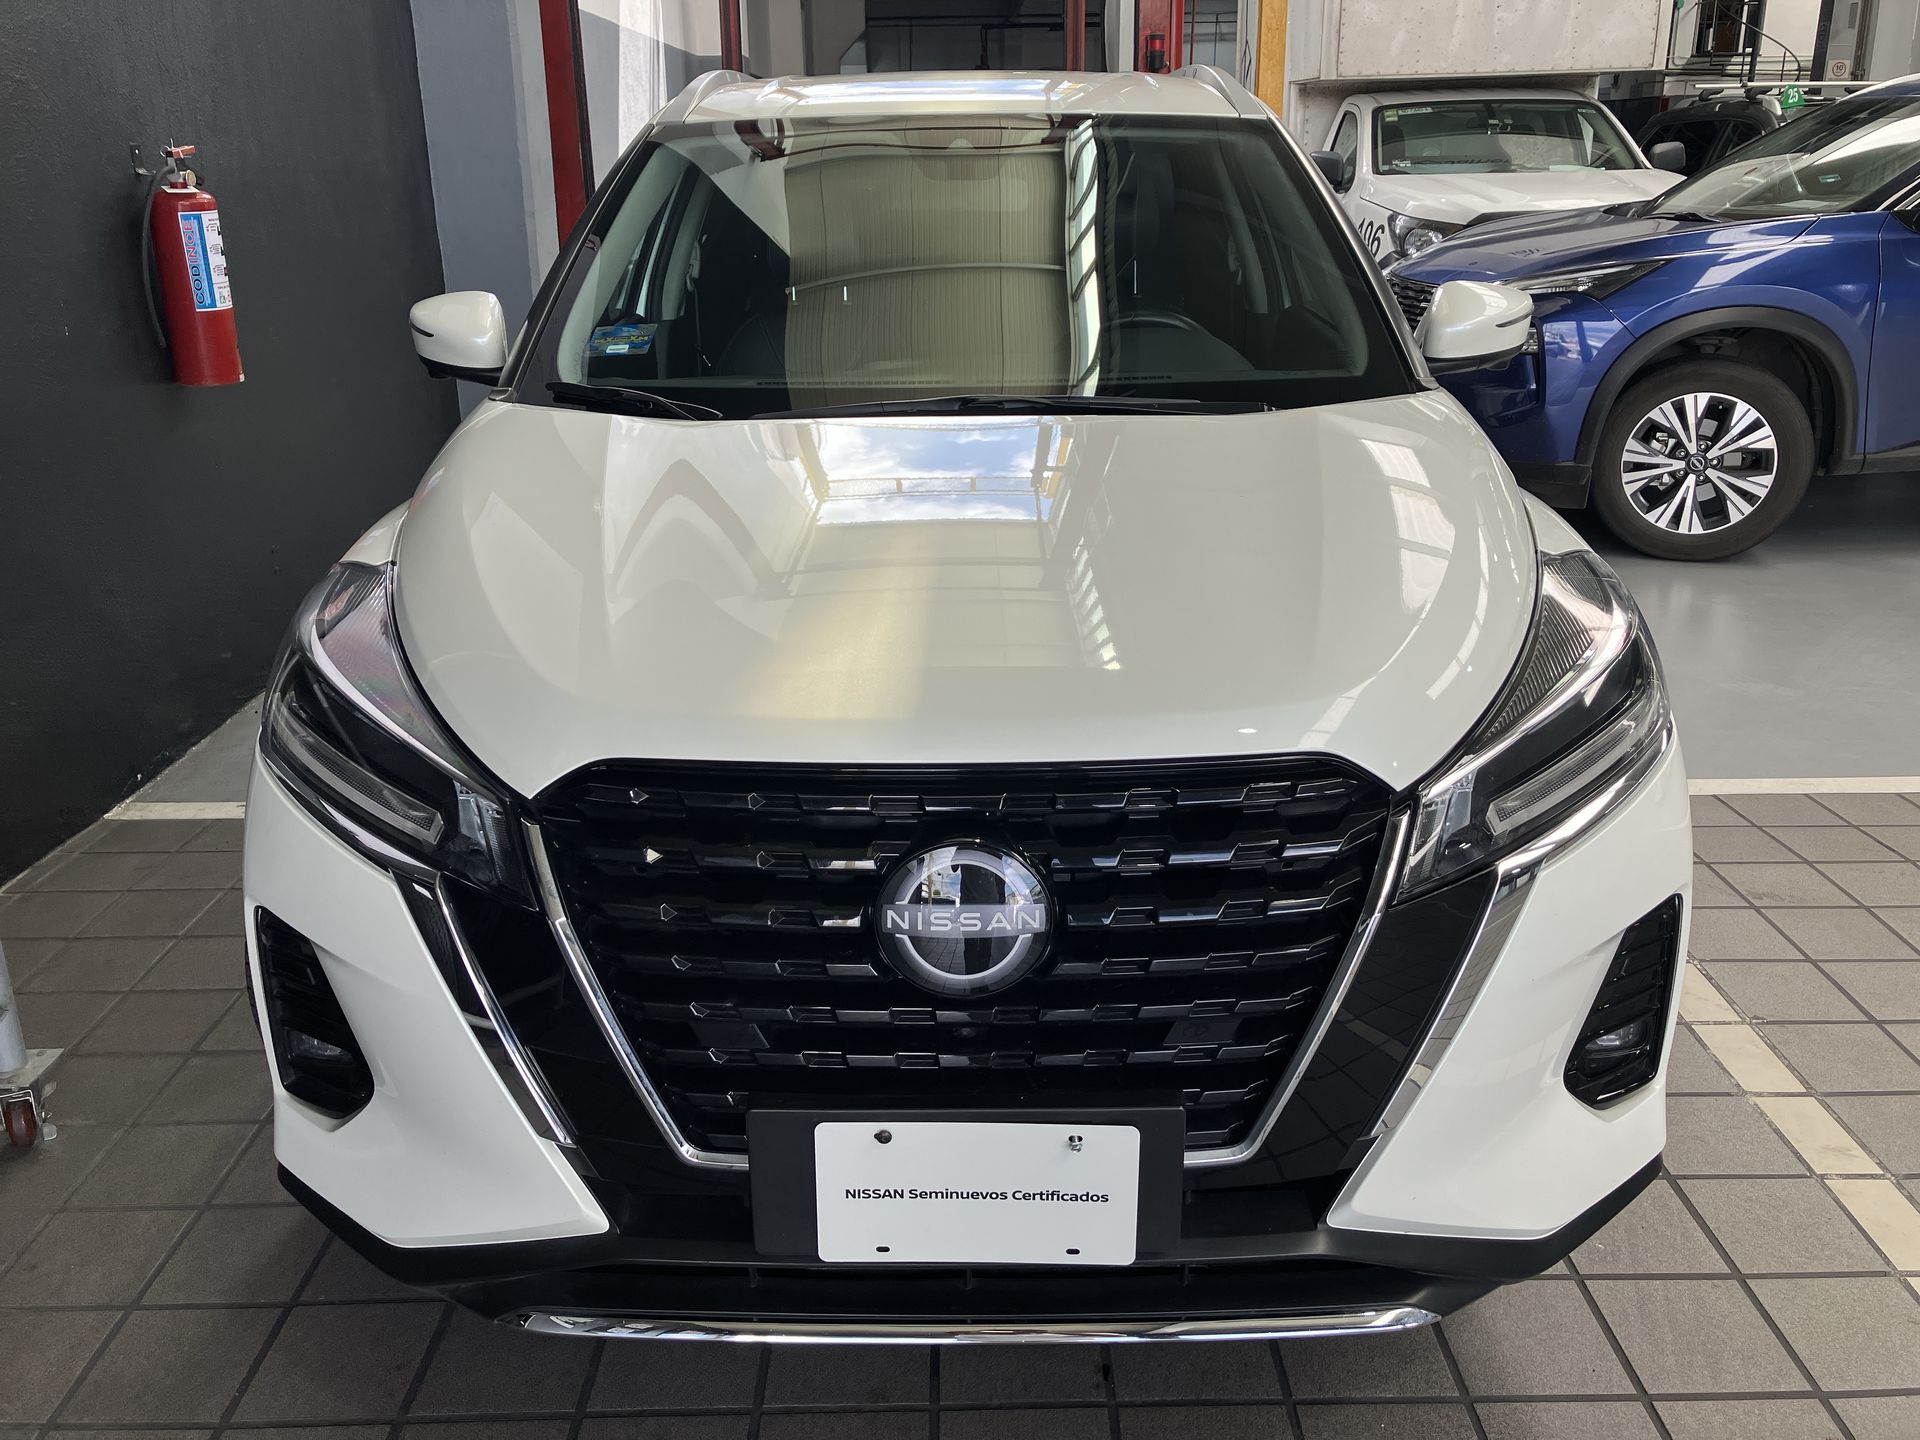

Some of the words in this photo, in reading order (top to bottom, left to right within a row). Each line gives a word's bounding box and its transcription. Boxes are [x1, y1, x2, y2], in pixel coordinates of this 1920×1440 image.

[1788, 87, 1799, 103] 25
[183, 221, 205, 304] CODINCE
[886, 909, 1040, 931] NISSAN
[844, 1188, 905, 1200] NISSAN
[908, 1188, 1008, 1201] Seminuevos
[1011, 1189, 1110, 1203] Certificados
